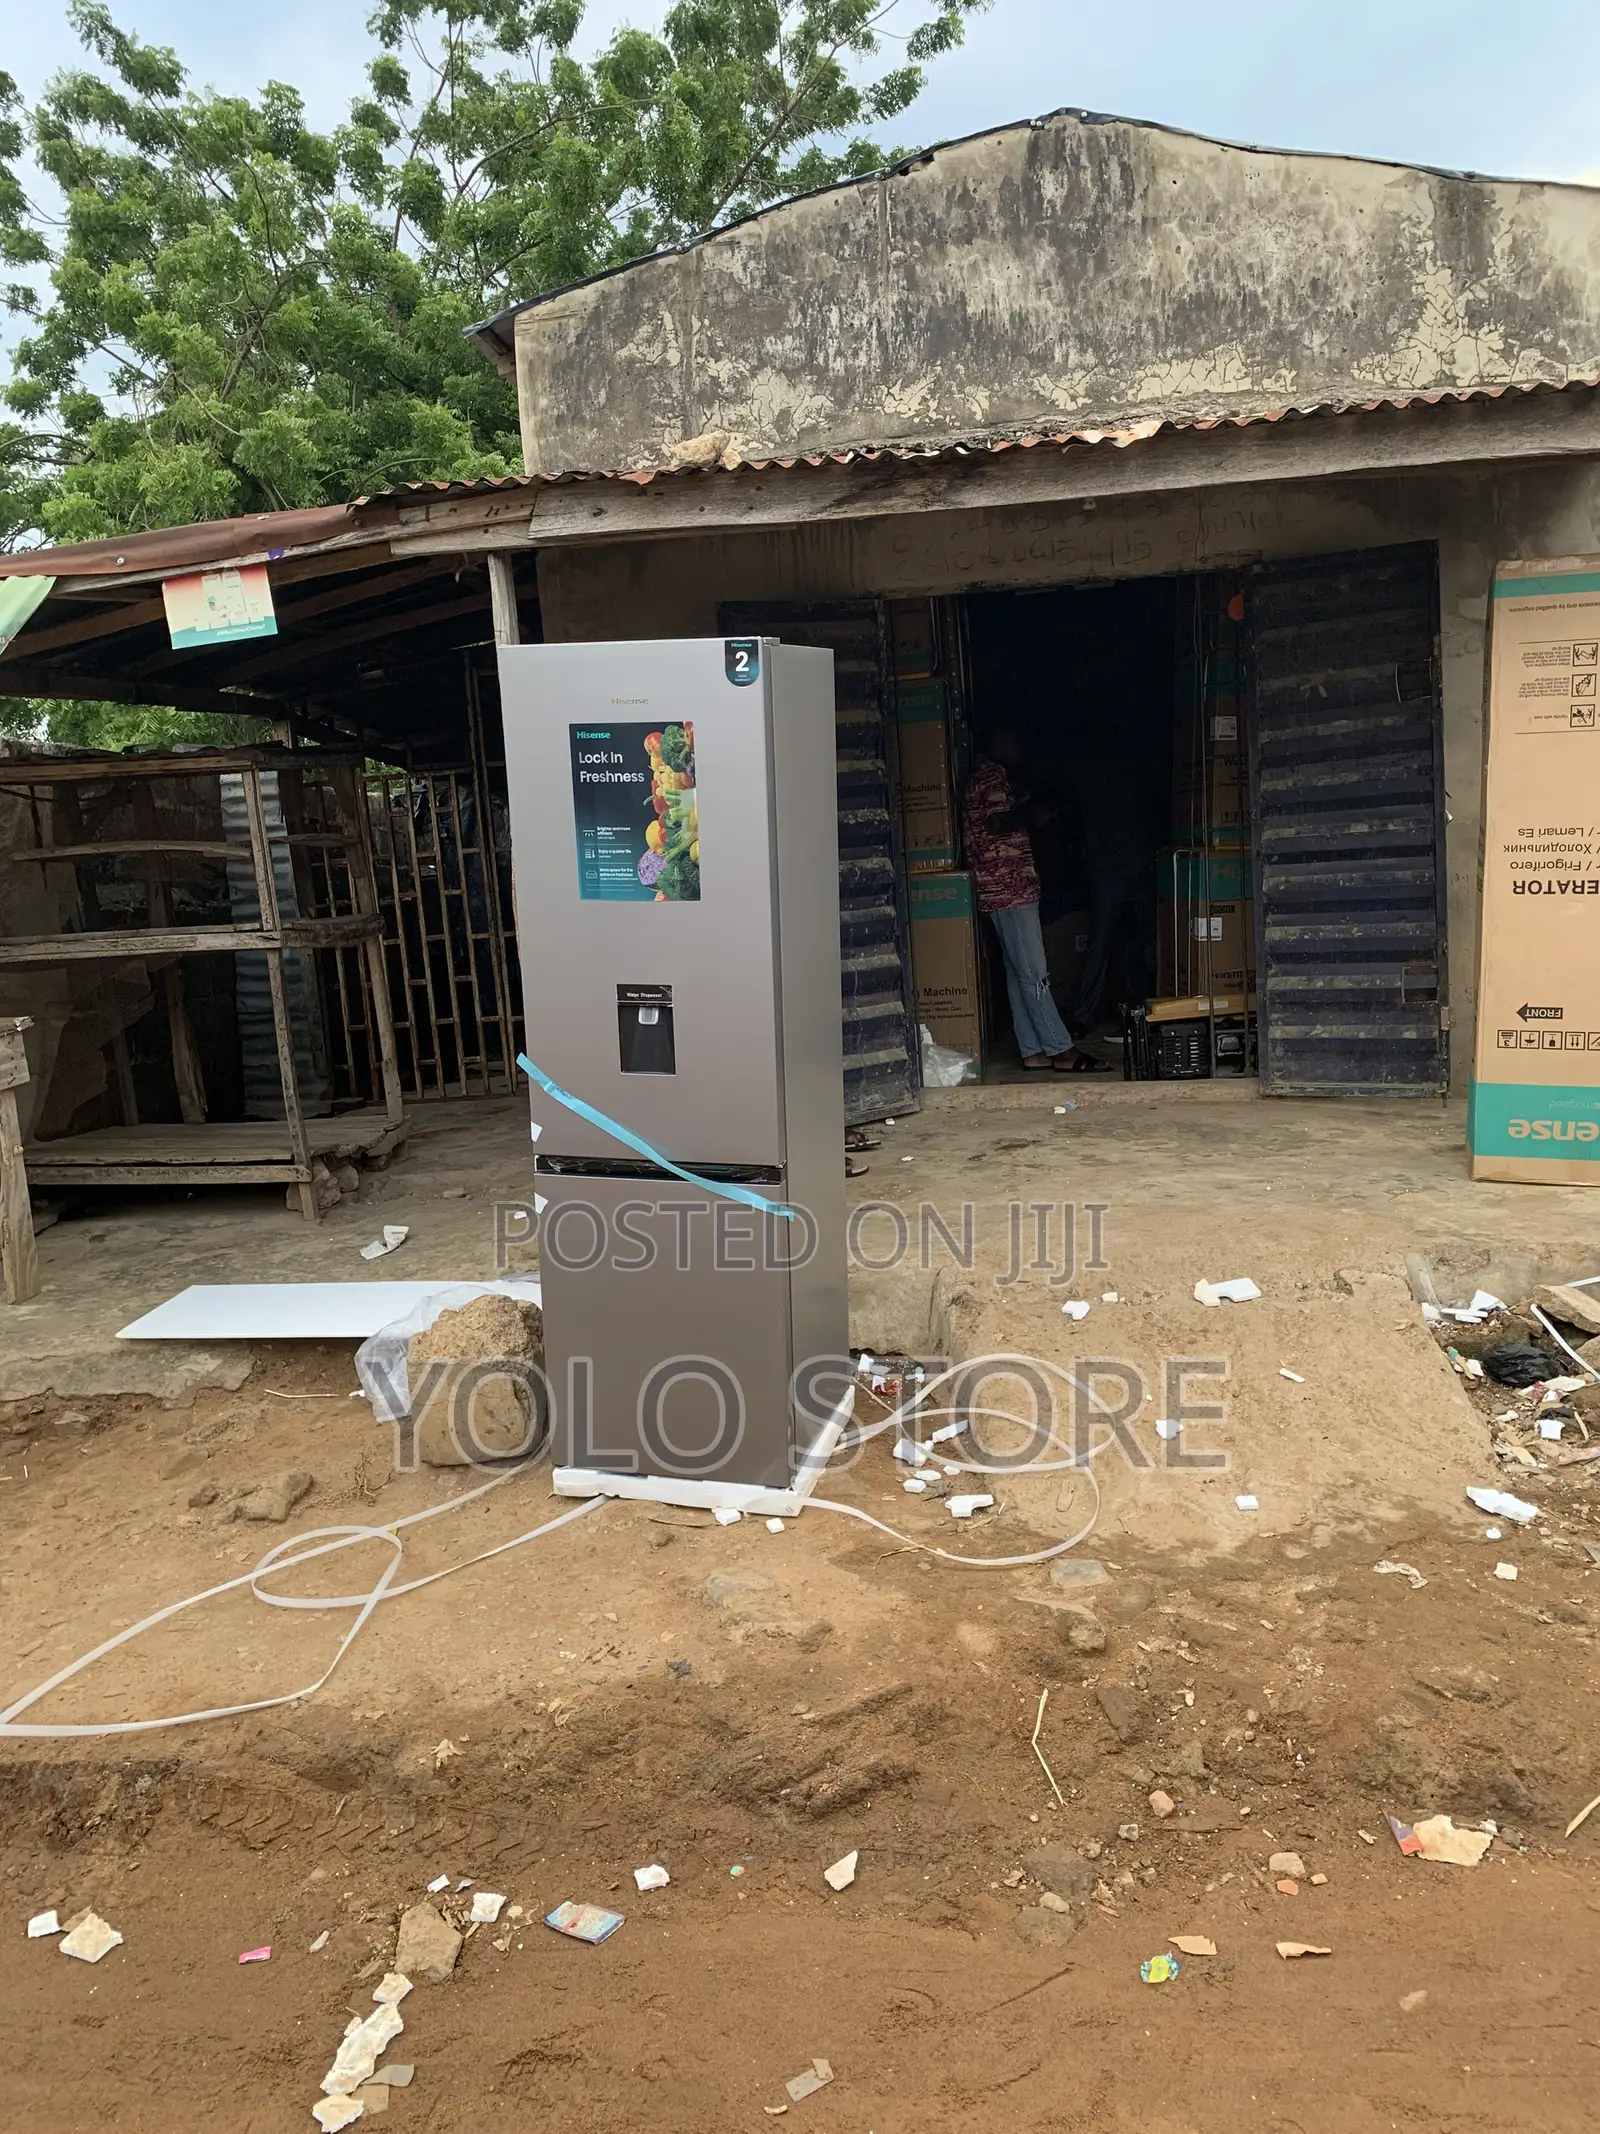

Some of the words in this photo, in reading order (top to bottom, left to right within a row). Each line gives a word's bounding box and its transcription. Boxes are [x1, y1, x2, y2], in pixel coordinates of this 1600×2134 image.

[736, 651, 750, 672] 2
[579, 751, 609, 764] Lock
[611, 752, 623, 763] In
[580, 770, 645, 783] Freshness
[1518, 828, 1534, 838] Es
[1538, 827, 1584, 838] Lemari
[1503, 842, 1592, 854] Холодильник
[1510, 859, 1581, 871] Frigorifero
[1512, 880, 1600, 894] ERATOR
[924, 986, 967, 996] Machine
[1525, 1009, 1561, 1018] FRONT
[1508, 1118, 1600, 1142] ense
